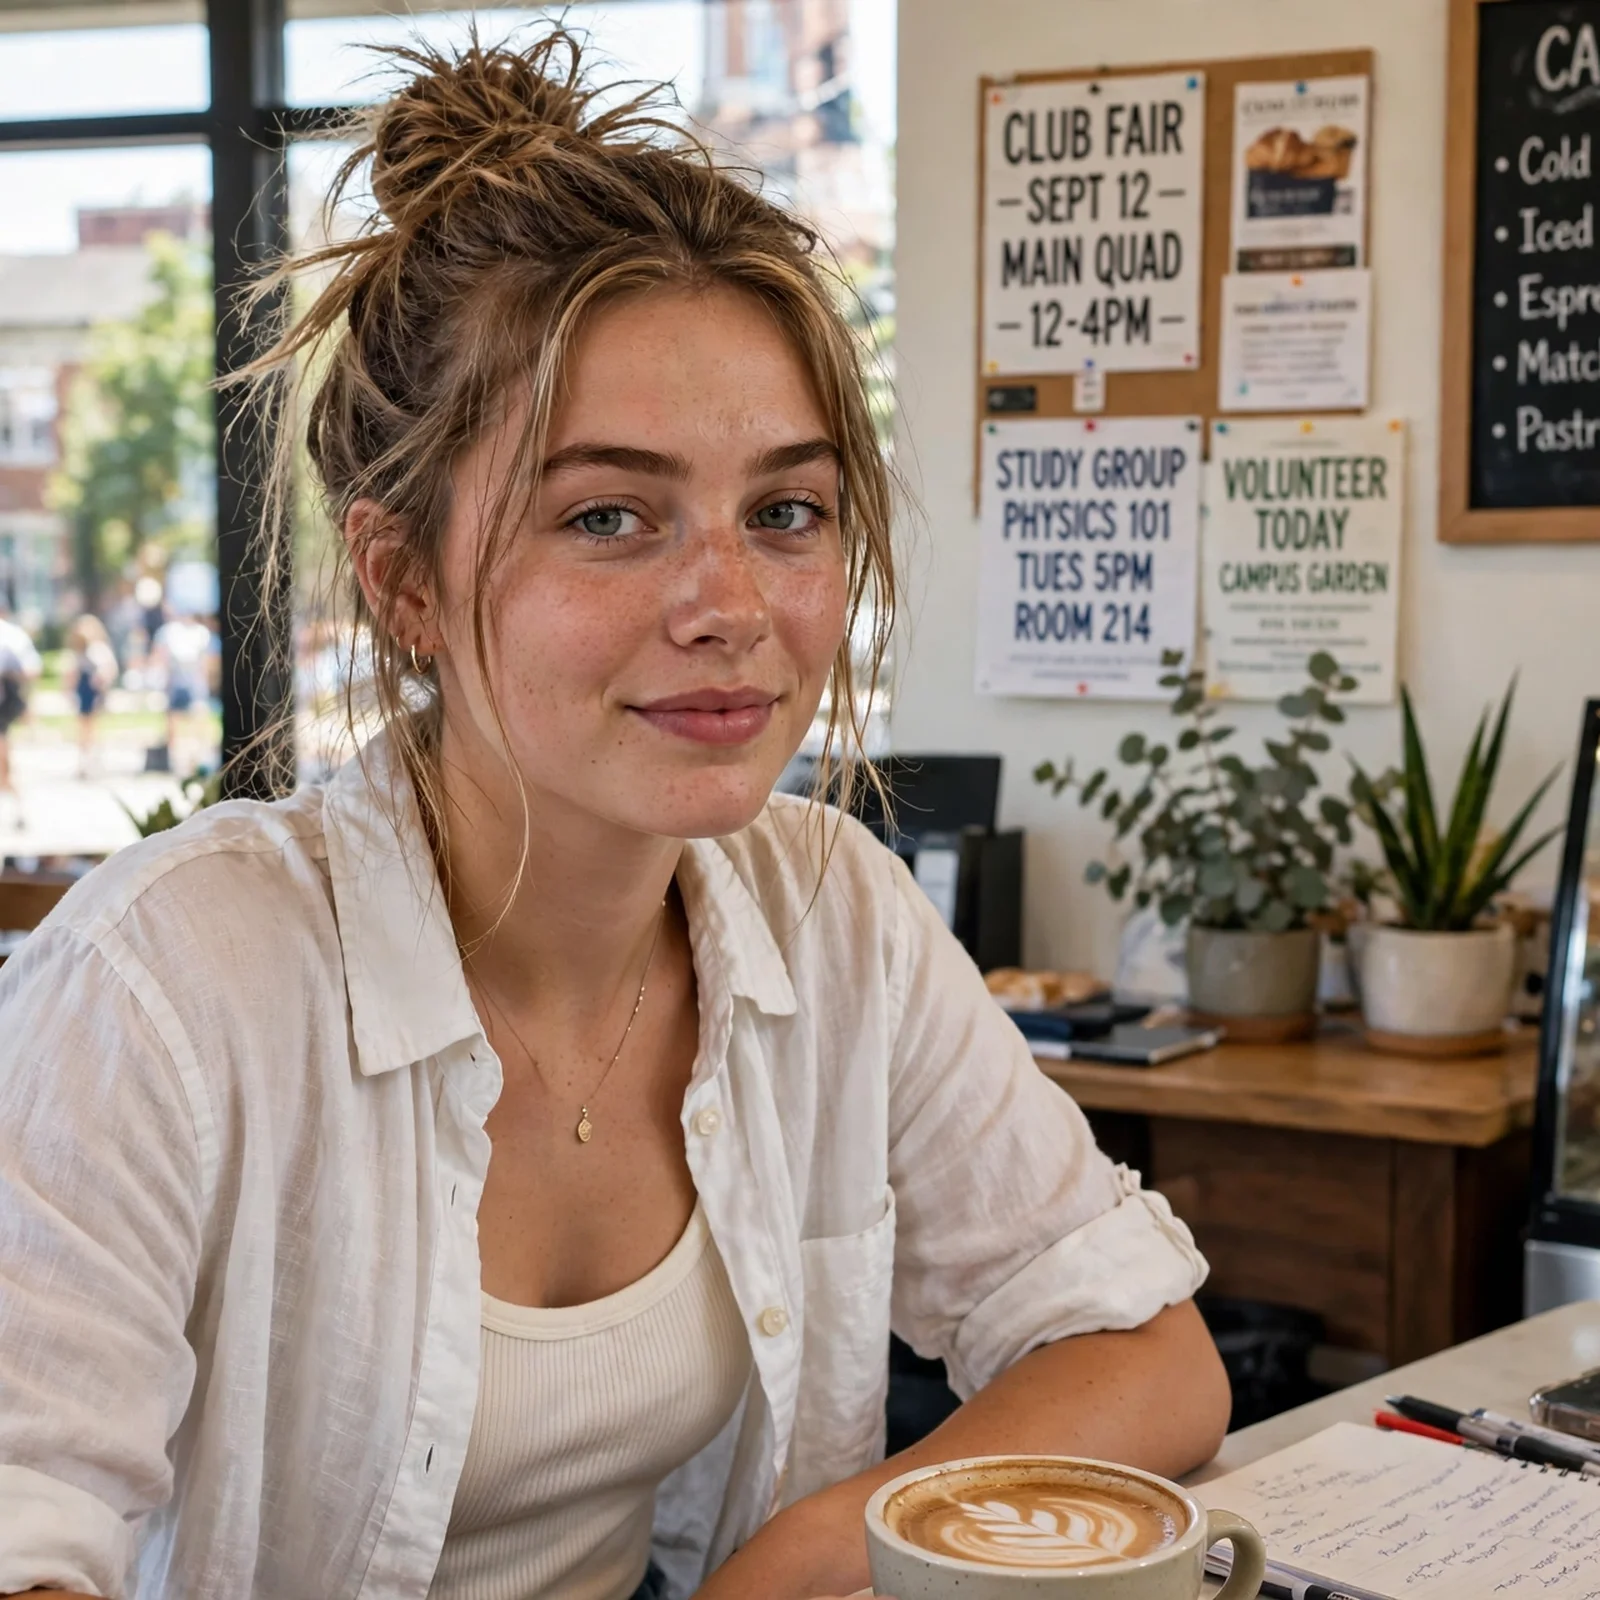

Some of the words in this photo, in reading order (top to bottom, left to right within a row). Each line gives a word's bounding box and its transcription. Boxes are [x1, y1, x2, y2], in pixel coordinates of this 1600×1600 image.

[1003, 108, 1093, 166] CLUB
[1104, 101, 1185, 158] FAIR
[1518, 132, 1592, 186] Cold
[1026, 171, 1104, 226] SEPT
[1116, 169, 1151, 221] 12
[1518, 202, 1594, 254] Iced
[1001, 234, 1084, 289] MAIN
[1094, 230, 1184, 291] QUAD
[1029, 296, 1152, 348] 12-4PM
[1516, 338, 1600, 386] Matc
[996, 449, 1083, 491] STUDY
[1092, 448, 1187, 489] GROUP
[1222, 456, 1388, 502] VOLUNTEER
[1003, 501, 1117, 542] PHYSICS
[1128, 499, 1172, 541] 101
[1254, 509, 1350, 550] TODAY
[1015, 551, 1085, 594] TUES
[1094, 552, 1154, 593] 5PM
[1218, 562, 1302, 595] CAMPUS
[1305, 562, 1389, 594] GARDEN
[1015, 602, 1094, 643] ROOM
[1102, 602, 1152, 643] 214
